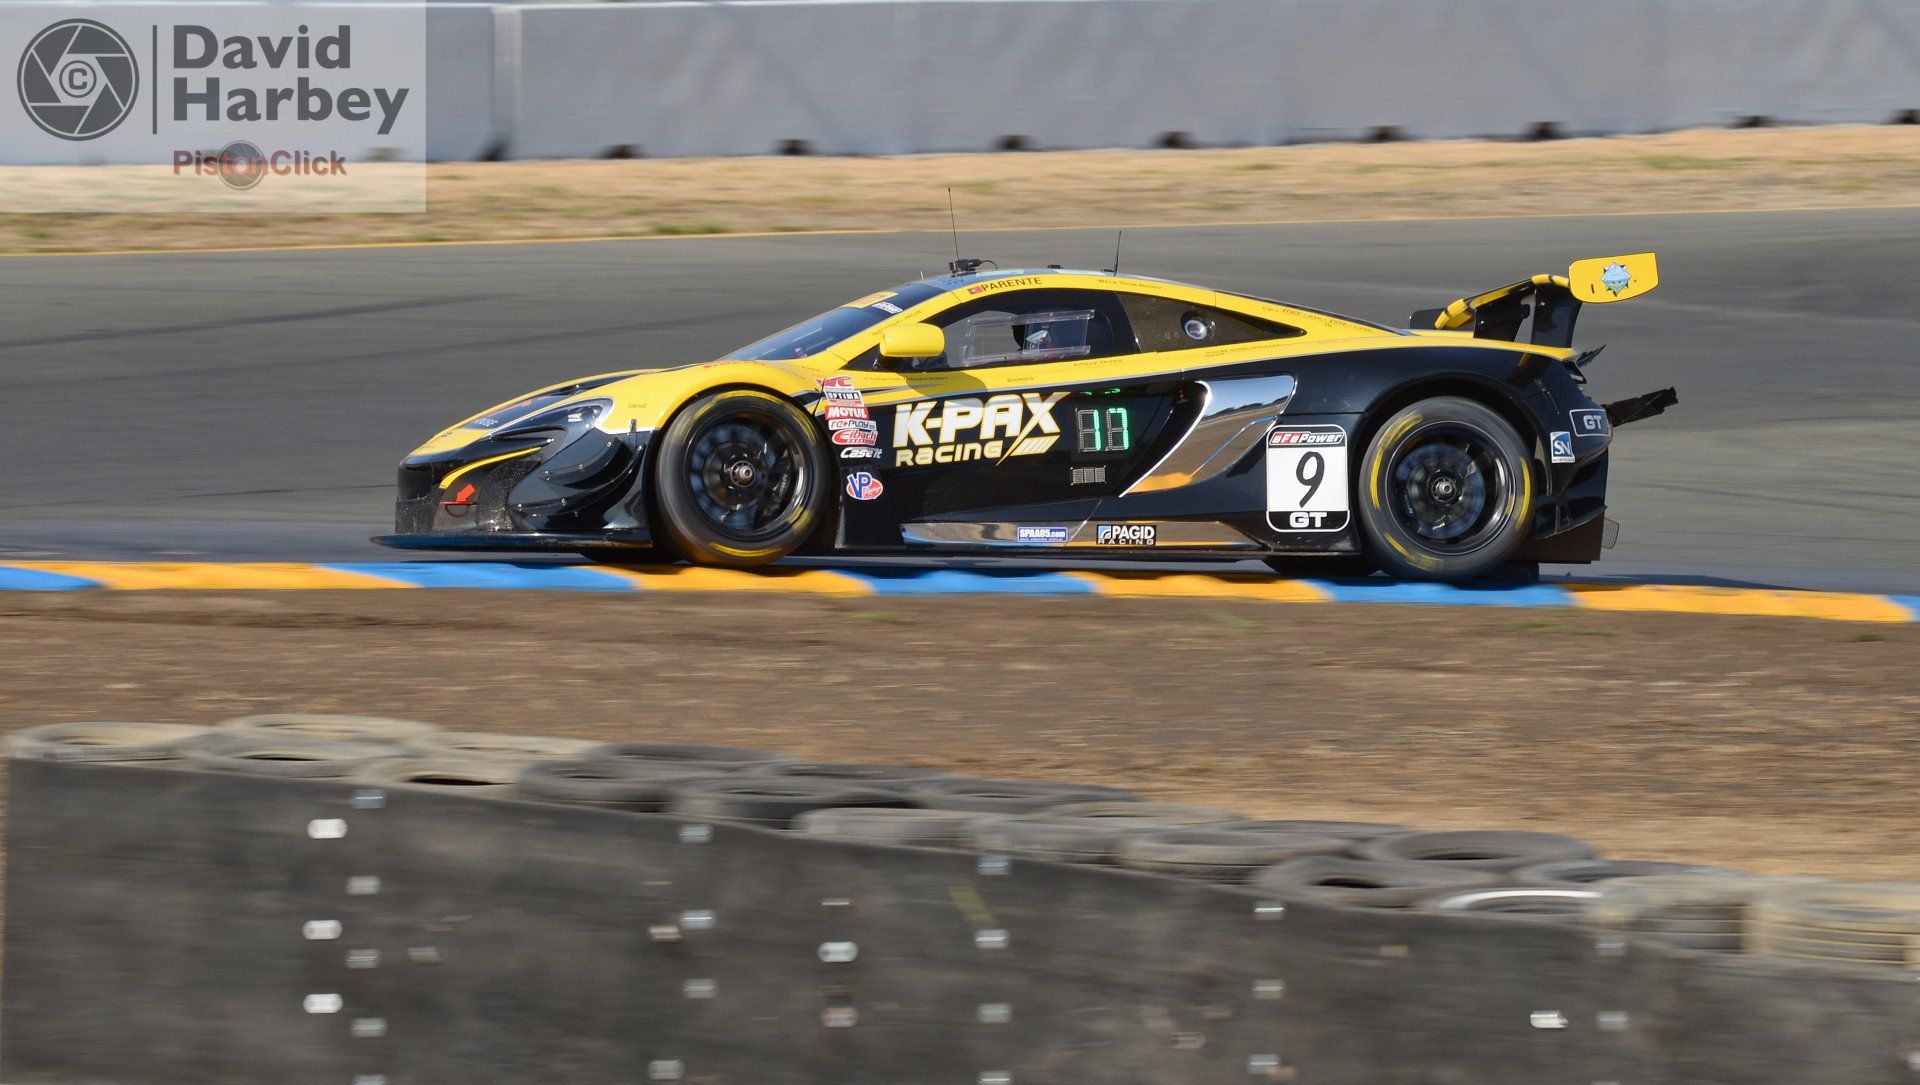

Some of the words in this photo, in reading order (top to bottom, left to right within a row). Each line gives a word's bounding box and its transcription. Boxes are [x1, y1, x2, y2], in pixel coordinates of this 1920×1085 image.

[981, 276, 1043, 292] PARENTE
[827, 391, 860, 400] OPTIMA
[827, 406, 868, 419] MOTUL
[892, 391, 1071, 450] K-PAX
[1583, 414, 1602, 430] GT
[847, 472, 872, 499] VP
[1295, 451, 1325, 508] 9
[1289, 511, 1328, 528] GT
[1112, 526, 1155, 540] PAGID
